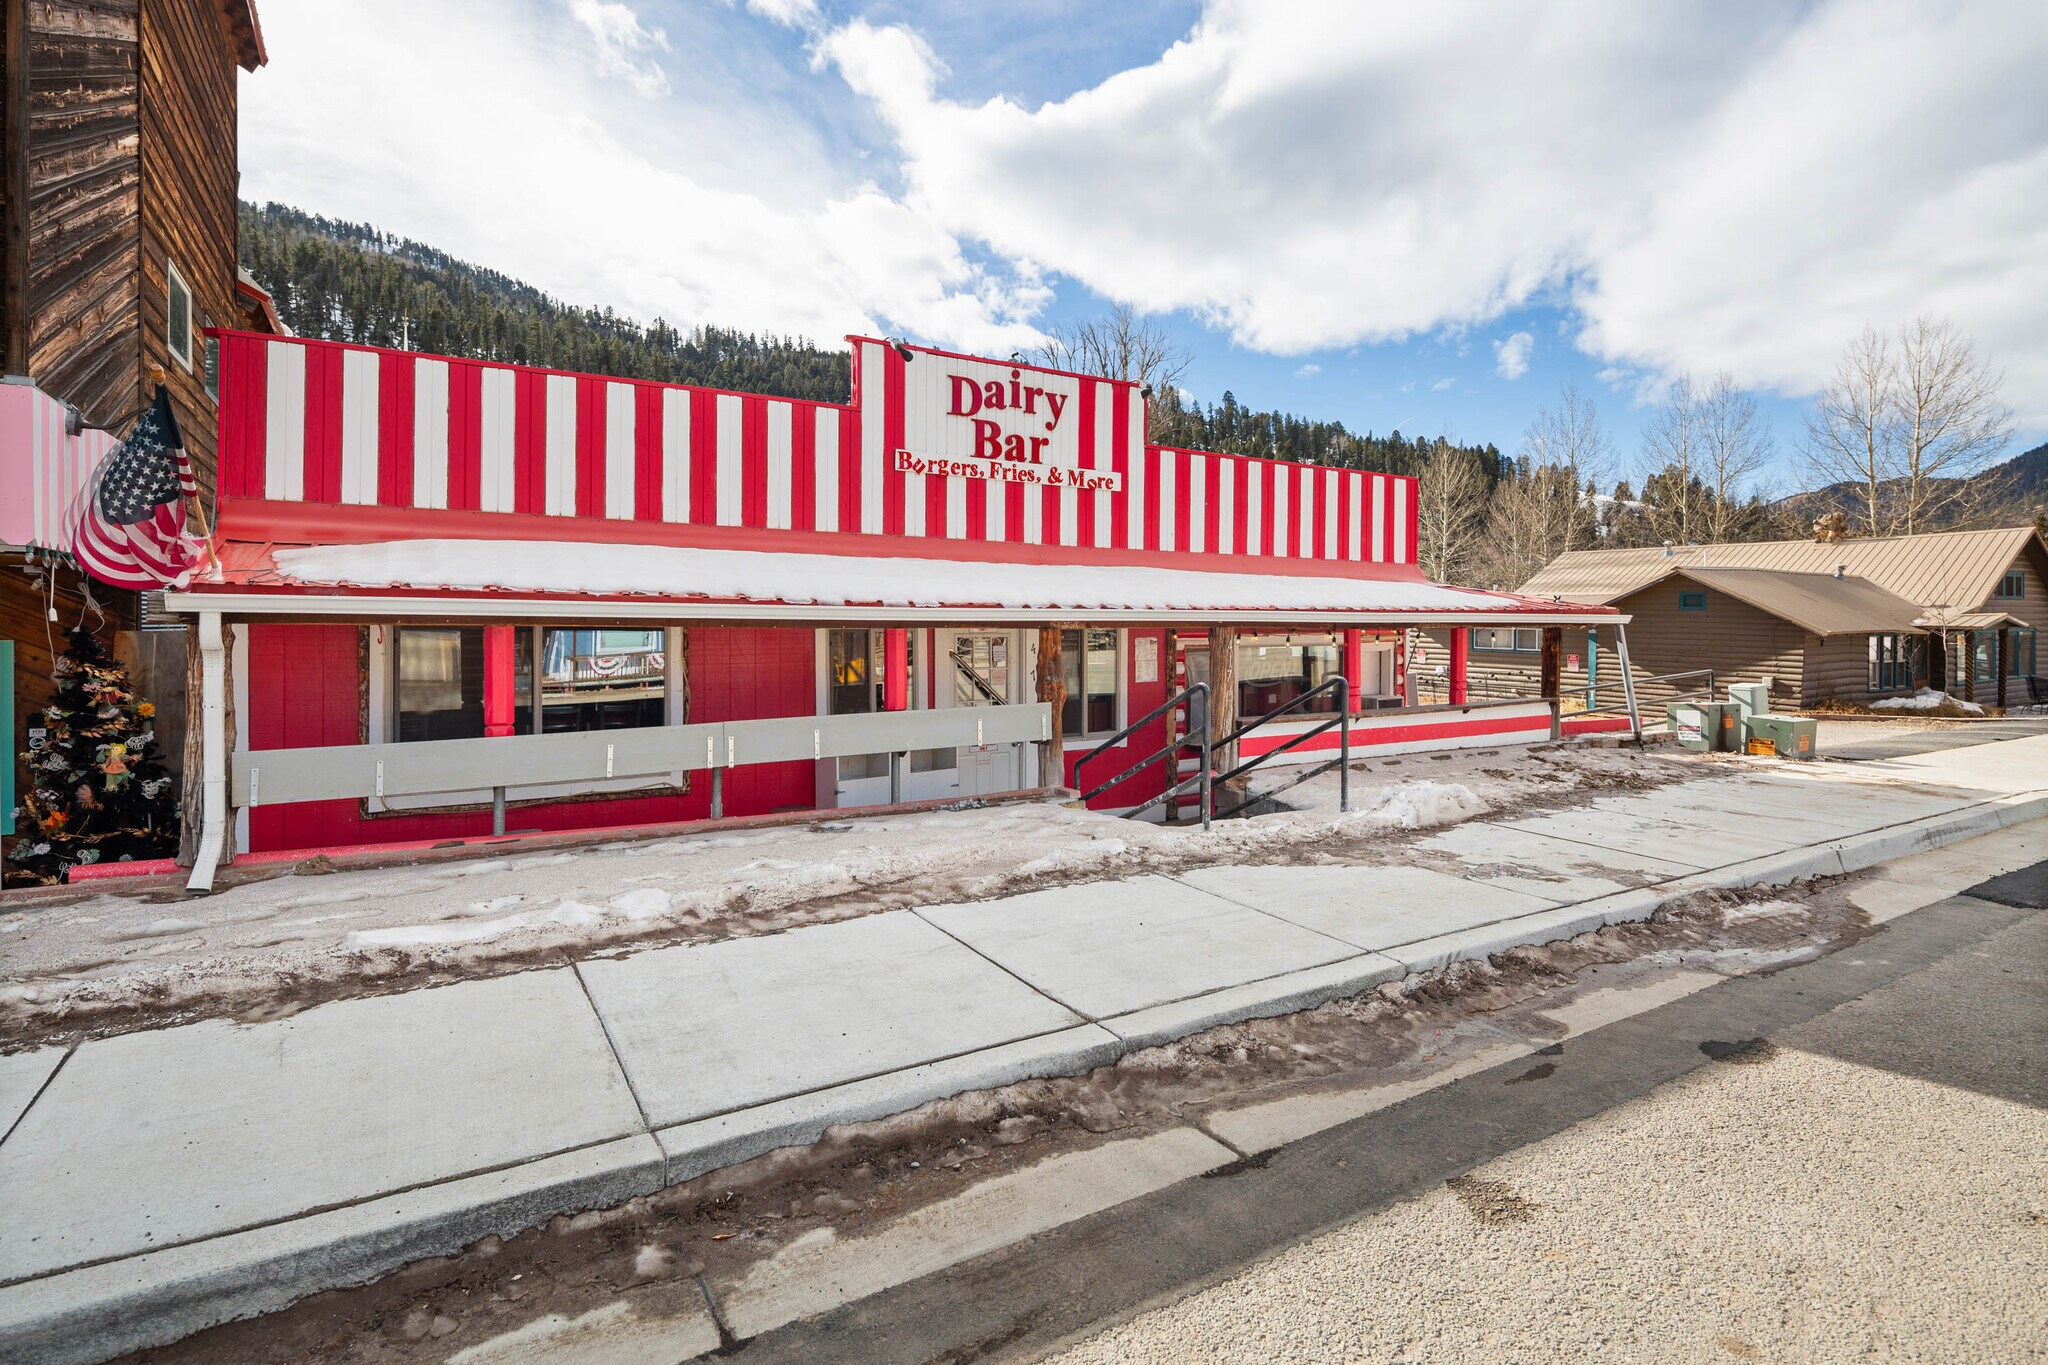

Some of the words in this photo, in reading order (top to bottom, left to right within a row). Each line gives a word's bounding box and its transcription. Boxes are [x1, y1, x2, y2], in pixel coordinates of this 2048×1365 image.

[947, 368, 1068, 431] Dairy
[970, 418, 1049, 464] Bar
[897, 450, 985, 477] Burgers,
[989, 461, 1041, 484] Fries,
[1047, 466, 1063, 484] &
[1067, 469, 1114, 491] More
